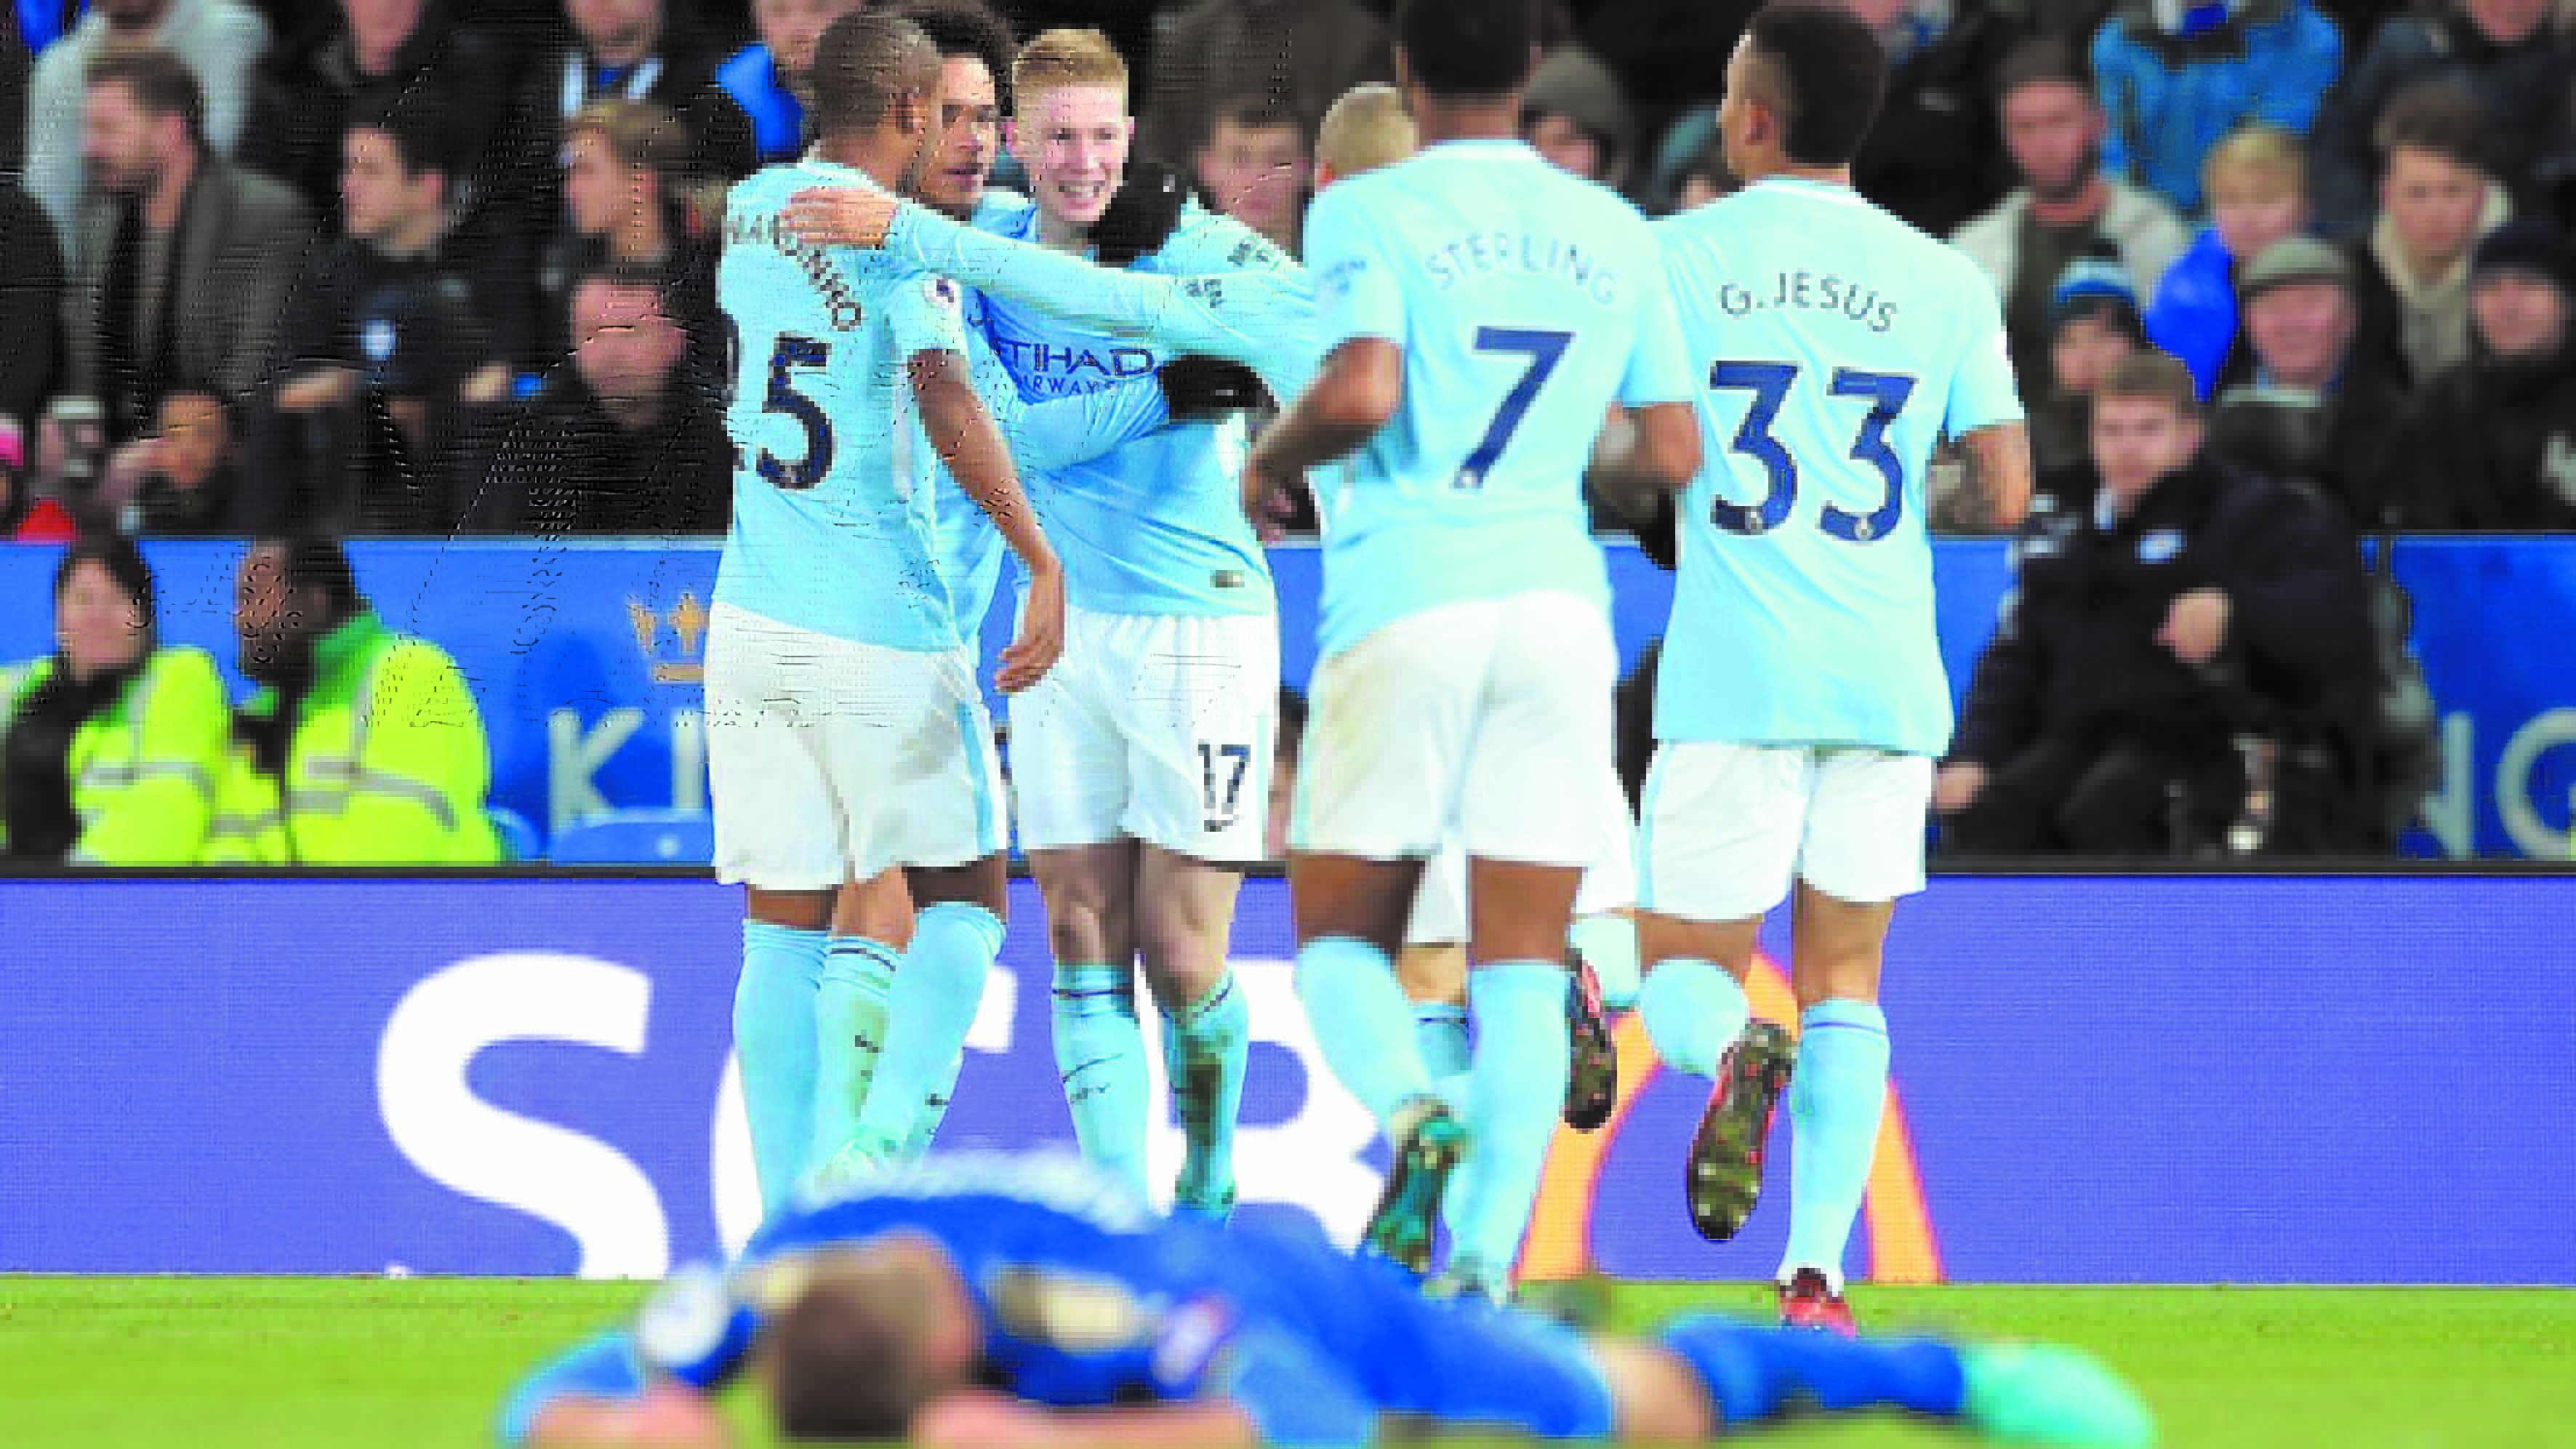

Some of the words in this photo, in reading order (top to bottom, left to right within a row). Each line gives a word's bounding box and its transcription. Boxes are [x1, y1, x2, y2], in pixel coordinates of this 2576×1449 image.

[1424, 231, 1617, 305] STERLING
[1719, 270, 1899, 333] G.JESUS
[723, 307, 833, 489] 5
[1454, 326, 1576, 489] 7
[1710, 360, 1919, 542] 33
[1197, 739, 1251, 814] 17
[378, 952, 1389, 1278] SB
